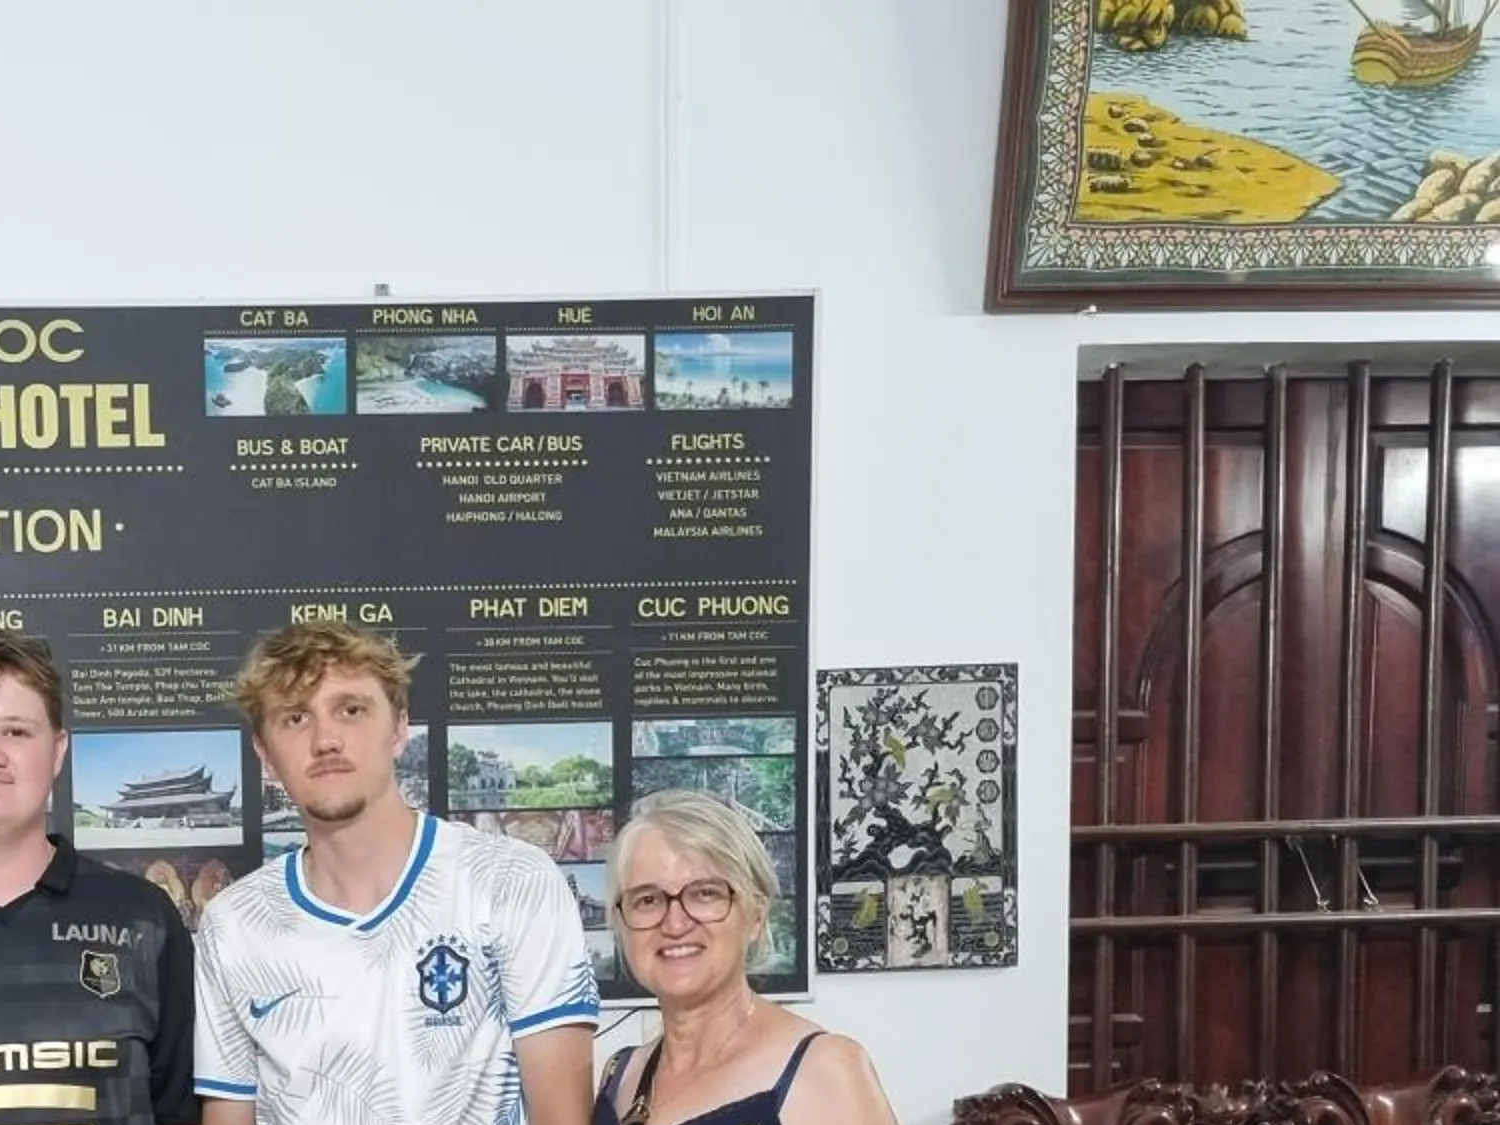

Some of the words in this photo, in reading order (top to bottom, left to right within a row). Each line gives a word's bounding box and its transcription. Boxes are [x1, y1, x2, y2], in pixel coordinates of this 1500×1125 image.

[240, 310, 276, 326] CAT
[284, 310, 308, 326] BA
[373, 309, 433, 325] PHONG
[442, 308, 478, 324] NHA
[693, 305, 724, 322] HOI
[731, 305, 754, 322] AN
[237, 439, 273, 456] BUS
[281, 439, 293, 455] &
[300, 438, 348, 455] BOAT
[421, 437, 491, 452] PRIVATE
[497, 436, 534, 451] CAR
[547, 436, 583, 451] BUS
[671, 433, 745, 450] FLIGHTS
[251, 478, 273, 489] CAT
[276, 478, 292, 488] BA
[295, 477, 337, 488] ISLAND
[442, 474, 478, 485] HANOI
[484, 474, 507, 485] OLD
[509, 474, 563, 484] QUARTER
[656, 472, 706, 482] VIETNAM
[709, 470, 761, 481] AIRLINES
[459, 493, 495, 504] HANOI
[498, 493, 546, 503] AIRPORT
[657, 490, 700, 500] VIETJET
[712, 489, 759, 499] JETSTAR
[446, 511, 505, 522] HAIPHONG
[516, 511, 563, 521] HALONG
[670, 508, 693, 519] ANA
[703, 507, 747, 518] QANTAS
[653, 527, 708, 537] MALAYSIA
[711, 525, 763, 536] AIRLINES
[359, 604, 393, 624] GA
[470, 599, 525, 619] PHAT
[539, 598, 588, 617] DIEM
[638, 598, 687, 618] CUC
[698, 596, 790, 617] PHUONG
[103, 608, 140, 628] BAI
[152, 607, 203, 628] DINH
[698, 631, 725, 641] FROM
[138, 643, 165, 653] FROM
